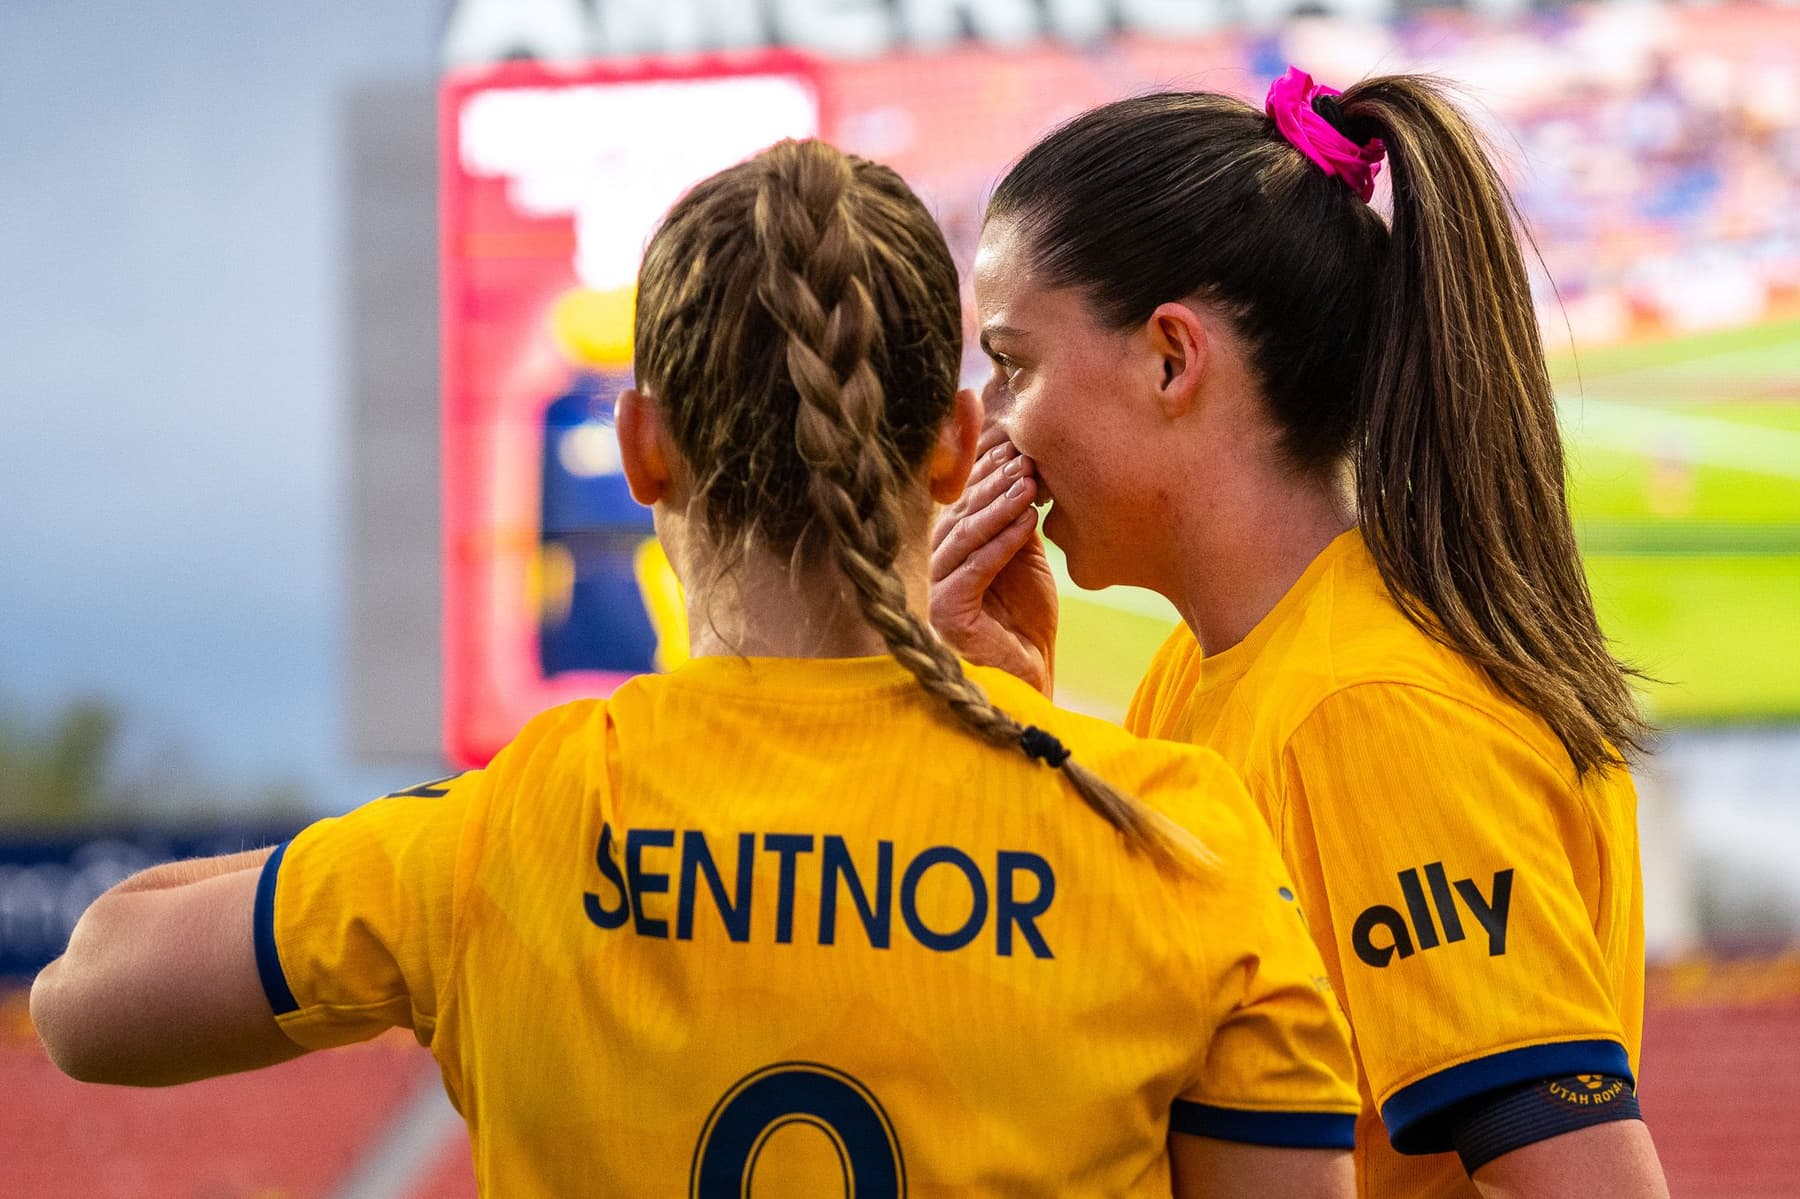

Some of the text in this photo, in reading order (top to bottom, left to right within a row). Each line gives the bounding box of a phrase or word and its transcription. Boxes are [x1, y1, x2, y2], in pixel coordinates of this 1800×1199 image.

[583, 822, 1056, 959] SENTNOR
[1351, 860, 1514, 968] ally
[1549, 1082, 1589, 1105] UTAH
